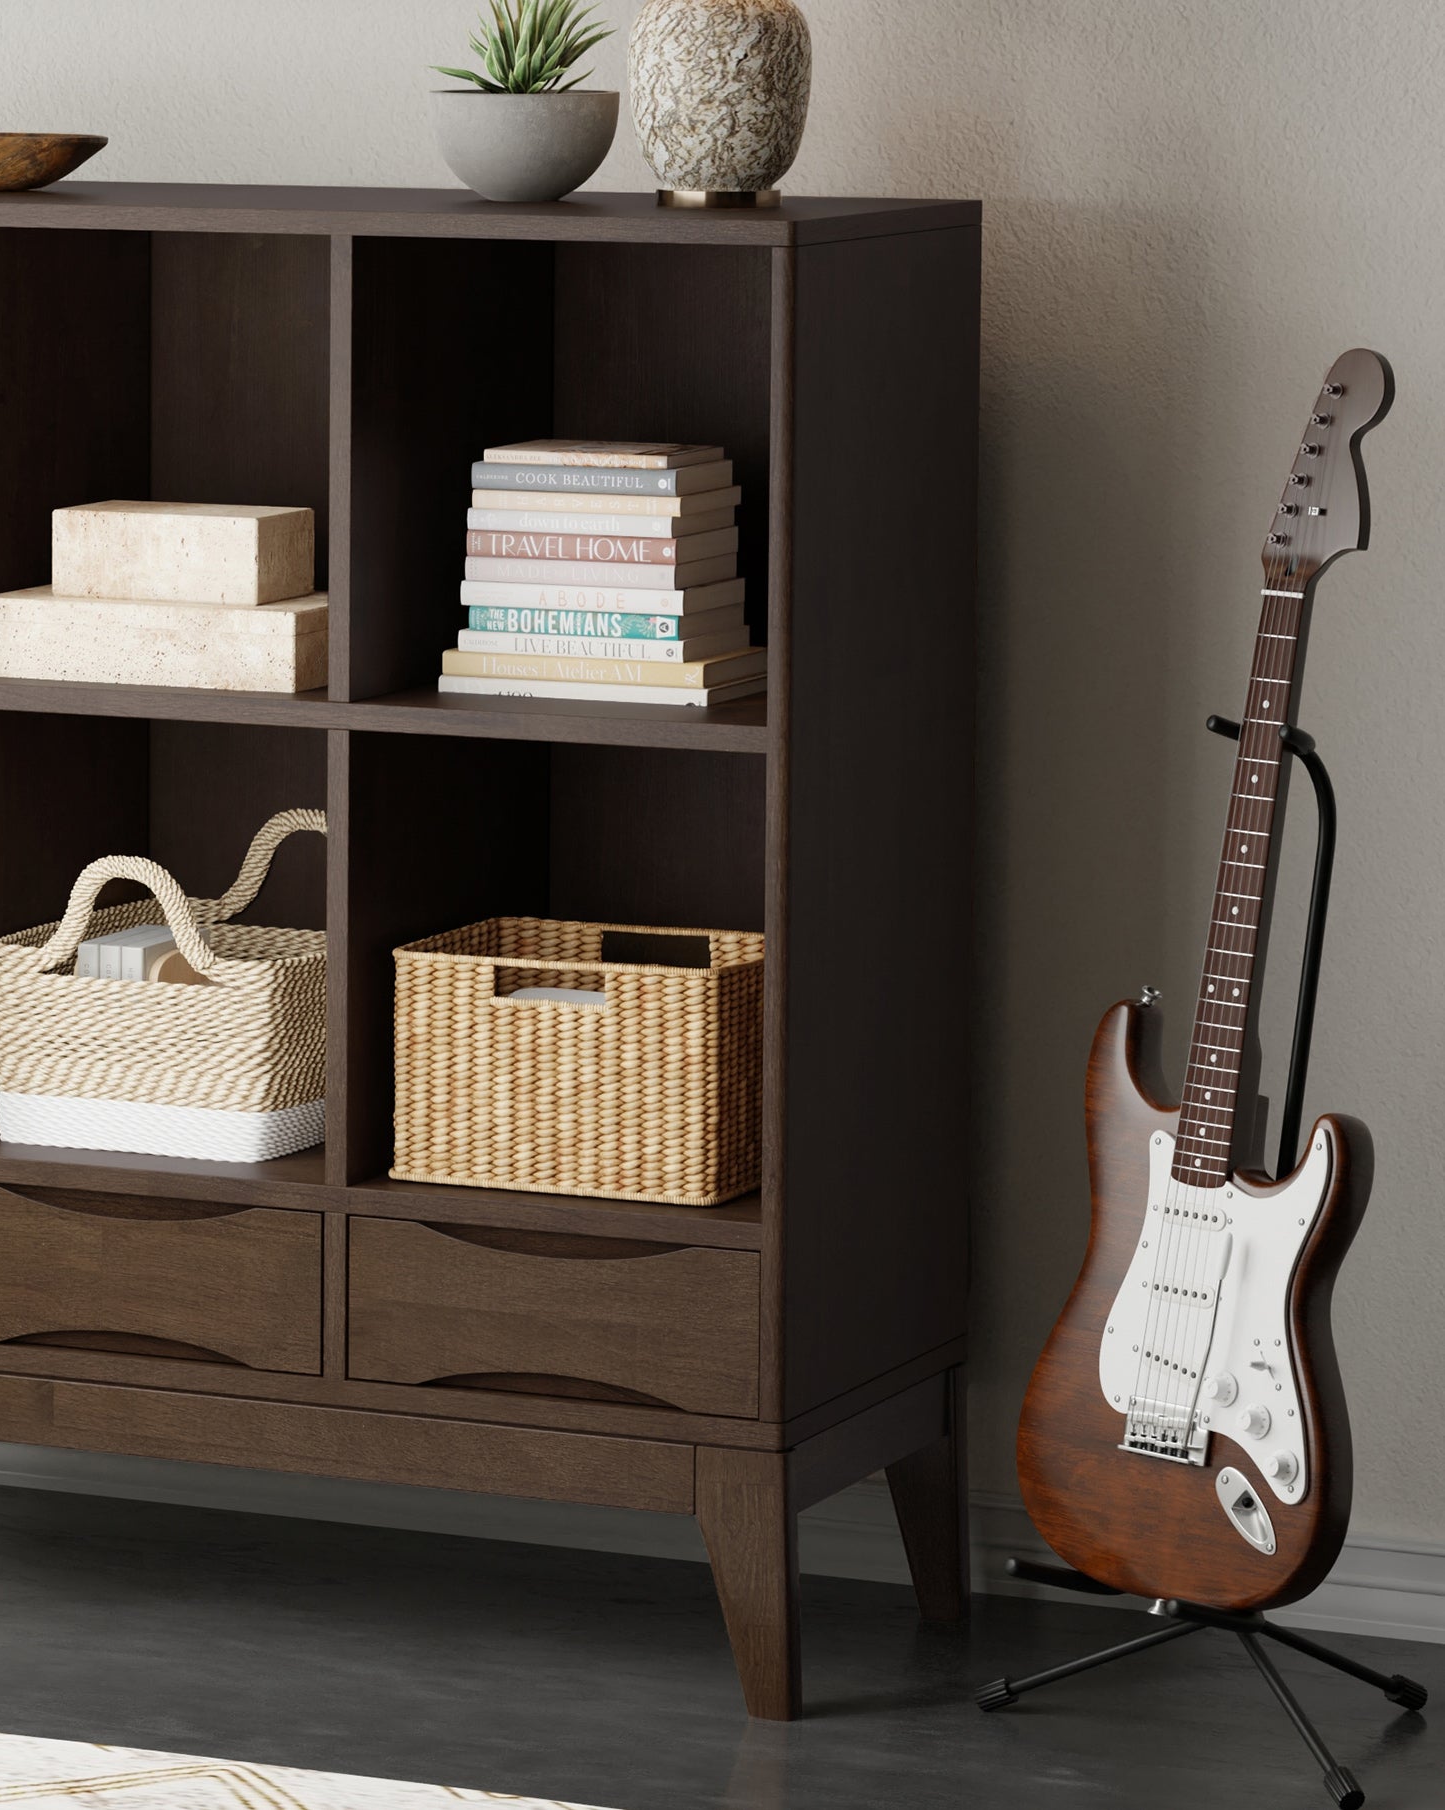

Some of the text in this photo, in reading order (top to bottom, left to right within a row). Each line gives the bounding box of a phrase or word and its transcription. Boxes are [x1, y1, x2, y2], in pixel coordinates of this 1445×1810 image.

[515, 472, 644, 489] COOK BEAUTIFUL
[519, 512, 620, 532] down to earth
[487, 533, 570, 559] TRAVEL
[576, 537, 652, 563] HOME
[497, 564, 553, 579] MADE
[571, 567, 640, 583] LIVING
[539, 590, 625, 609] ABODE
[489, 608, 505, 620] THE
[507, 608, 622, 637] BOHEMIANS
[486, 620, 505, 631] NEW
[514, 637, 651, 659] LIVE BEAUTIFUL
[482, 656, 642, 682] Houses Atelier AM
